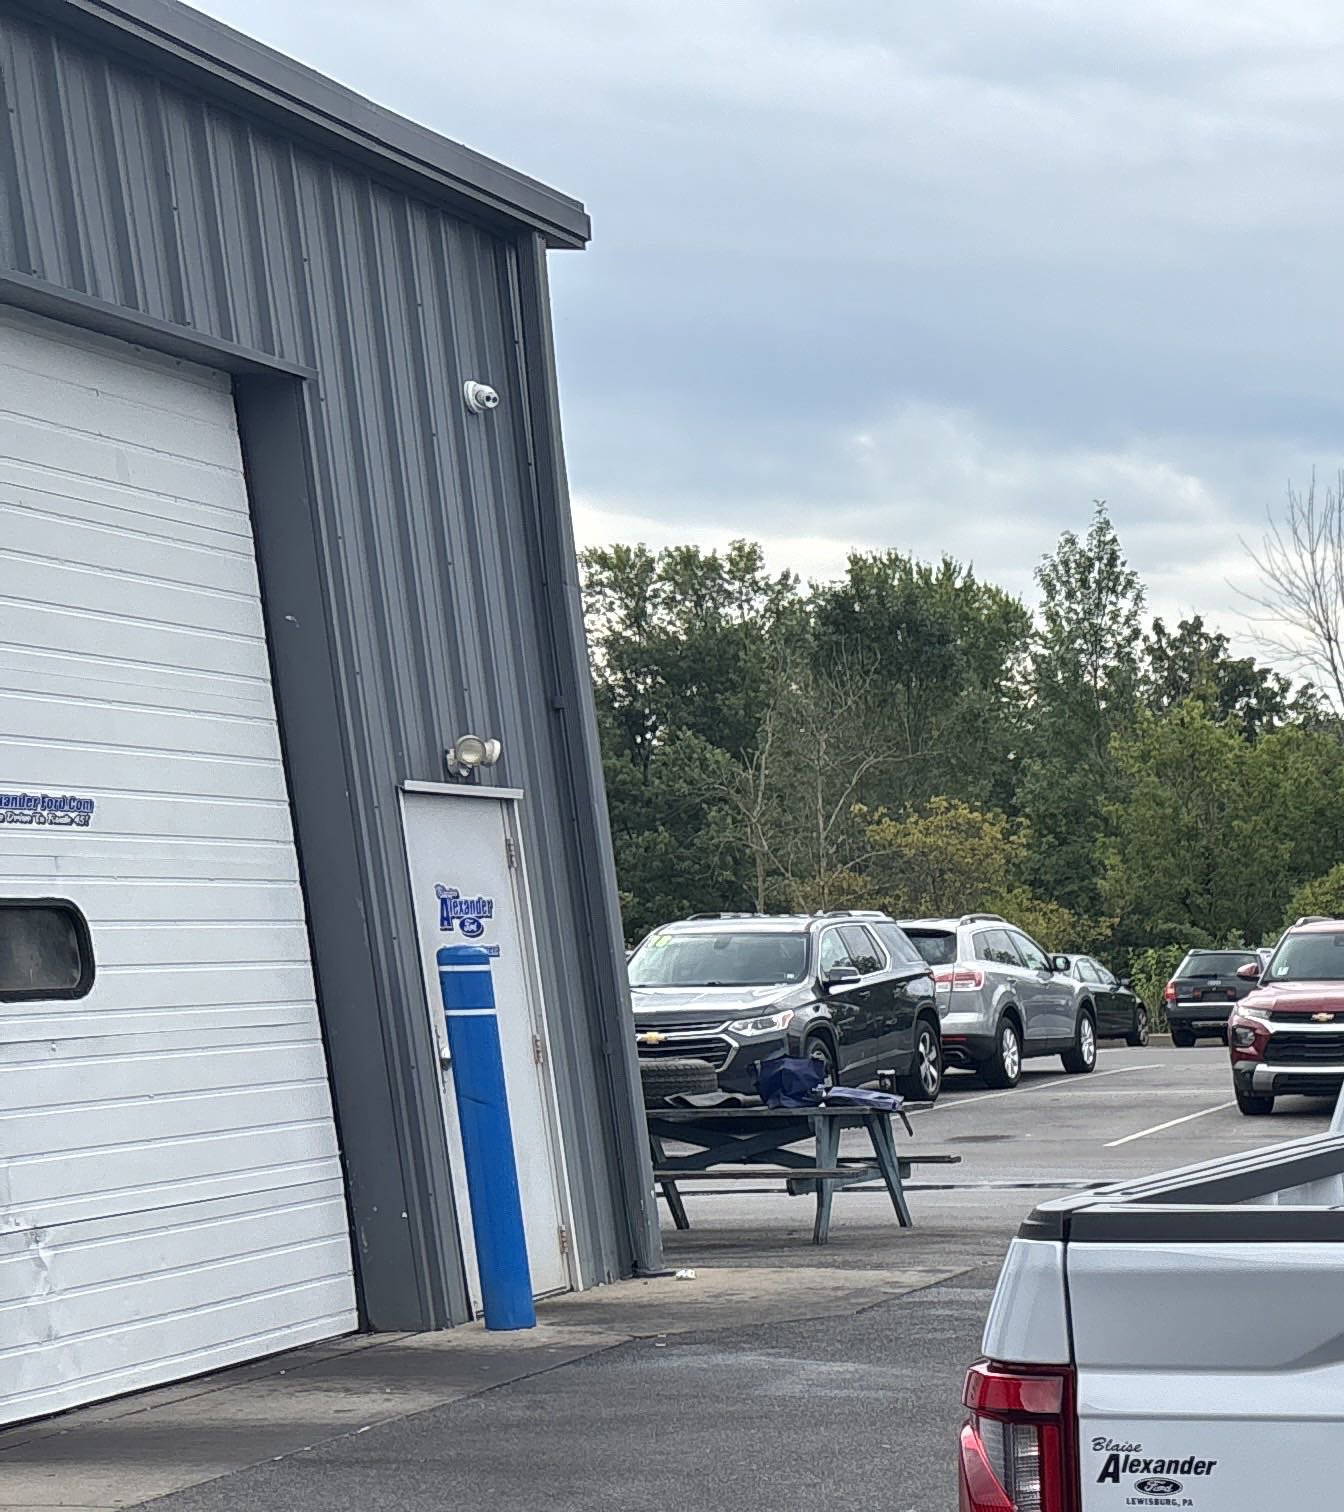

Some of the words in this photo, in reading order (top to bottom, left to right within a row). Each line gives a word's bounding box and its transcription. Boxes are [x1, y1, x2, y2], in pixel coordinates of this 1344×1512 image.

[41, 794, 66, 812] Ford
[440, 897, 493, 931] Alexander
[1092, 1437, 1143, 1452] Blaise
[1096, 1454, 1217, 1483] Alexander
[1144, 1480, 1173, 1492] Ford
[1126, 1498, 1180, 1507] LEWISBURG,
